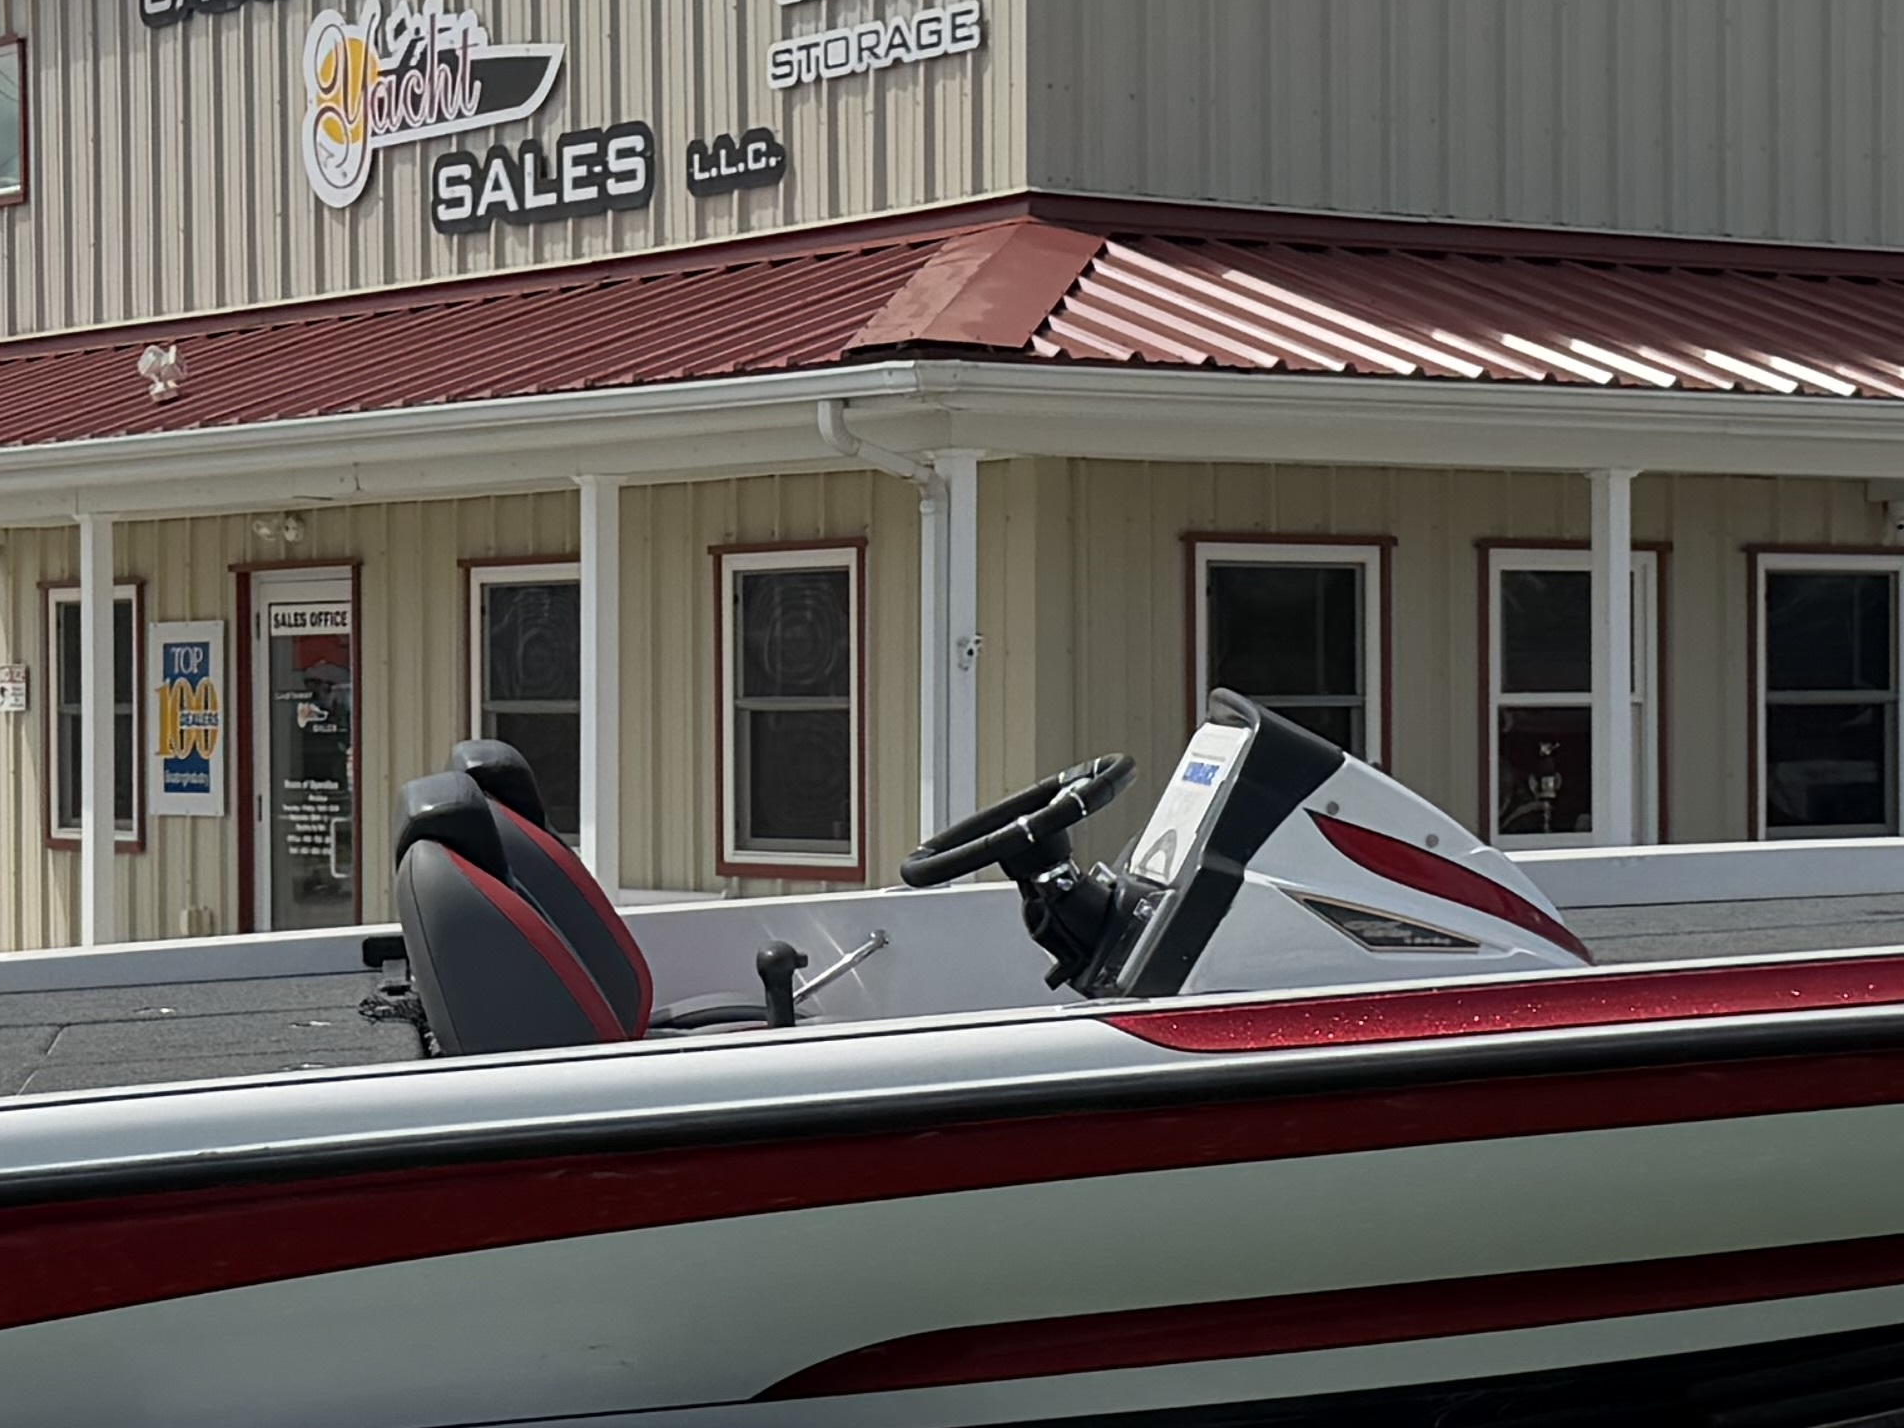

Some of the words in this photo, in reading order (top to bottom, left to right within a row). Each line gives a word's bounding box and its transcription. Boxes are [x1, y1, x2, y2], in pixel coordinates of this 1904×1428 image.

[771, 8, 975, 81] STORAGE
[312, 4, 484, 190] Yacht
[437, 134, 648, 223] SALES
[693, 141, 781, 182] L.L.C.
[273, 613, 307, 628] SALES
[310, 611, 348, 627] OFFICE
[171, 646, 203, 674] TOP
[154, 676, 218, 759] 100
